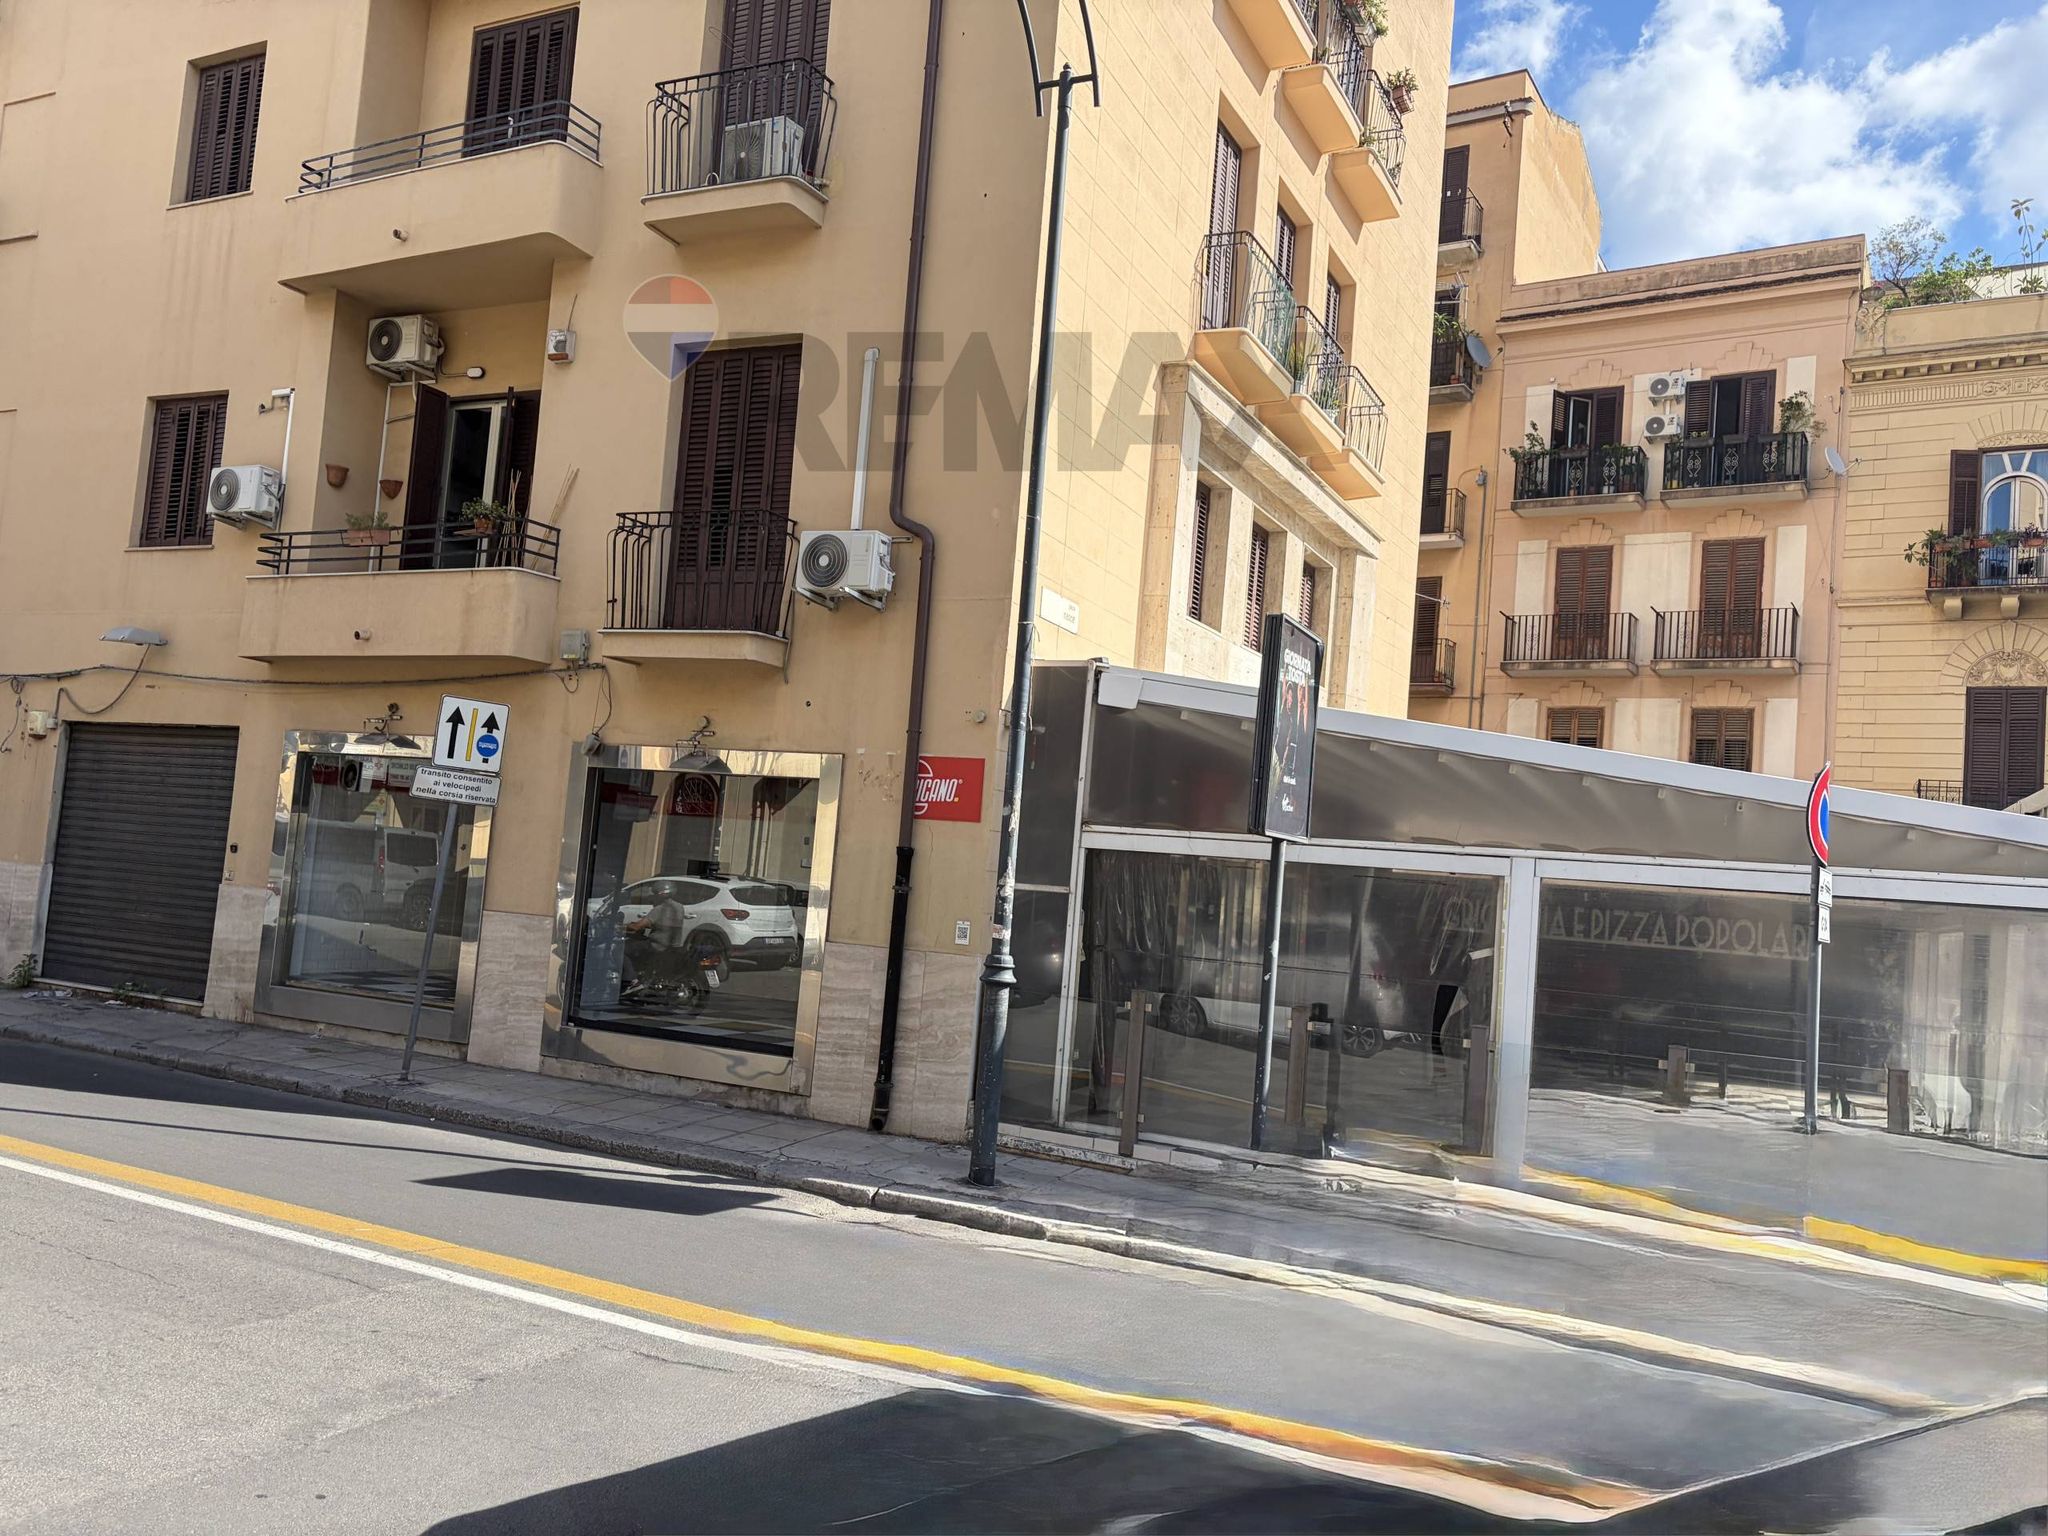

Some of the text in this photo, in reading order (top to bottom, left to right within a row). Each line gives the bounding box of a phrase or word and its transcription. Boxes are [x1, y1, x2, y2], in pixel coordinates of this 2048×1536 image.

[1284, 648, 1311, 675] GIORNATA
[1288, 665, 1305, 687] TOSTA
[421, 768, 451, 779] transito
[453, 773, 493, 785] consentito
[442, 780, 481, 792] velocipedi
[416, 786, 496, 804] nella corsia riservata
[1591, 907, 1669, 946] PIZZA
[1675, 911, 1811, 957] POPOLAR
